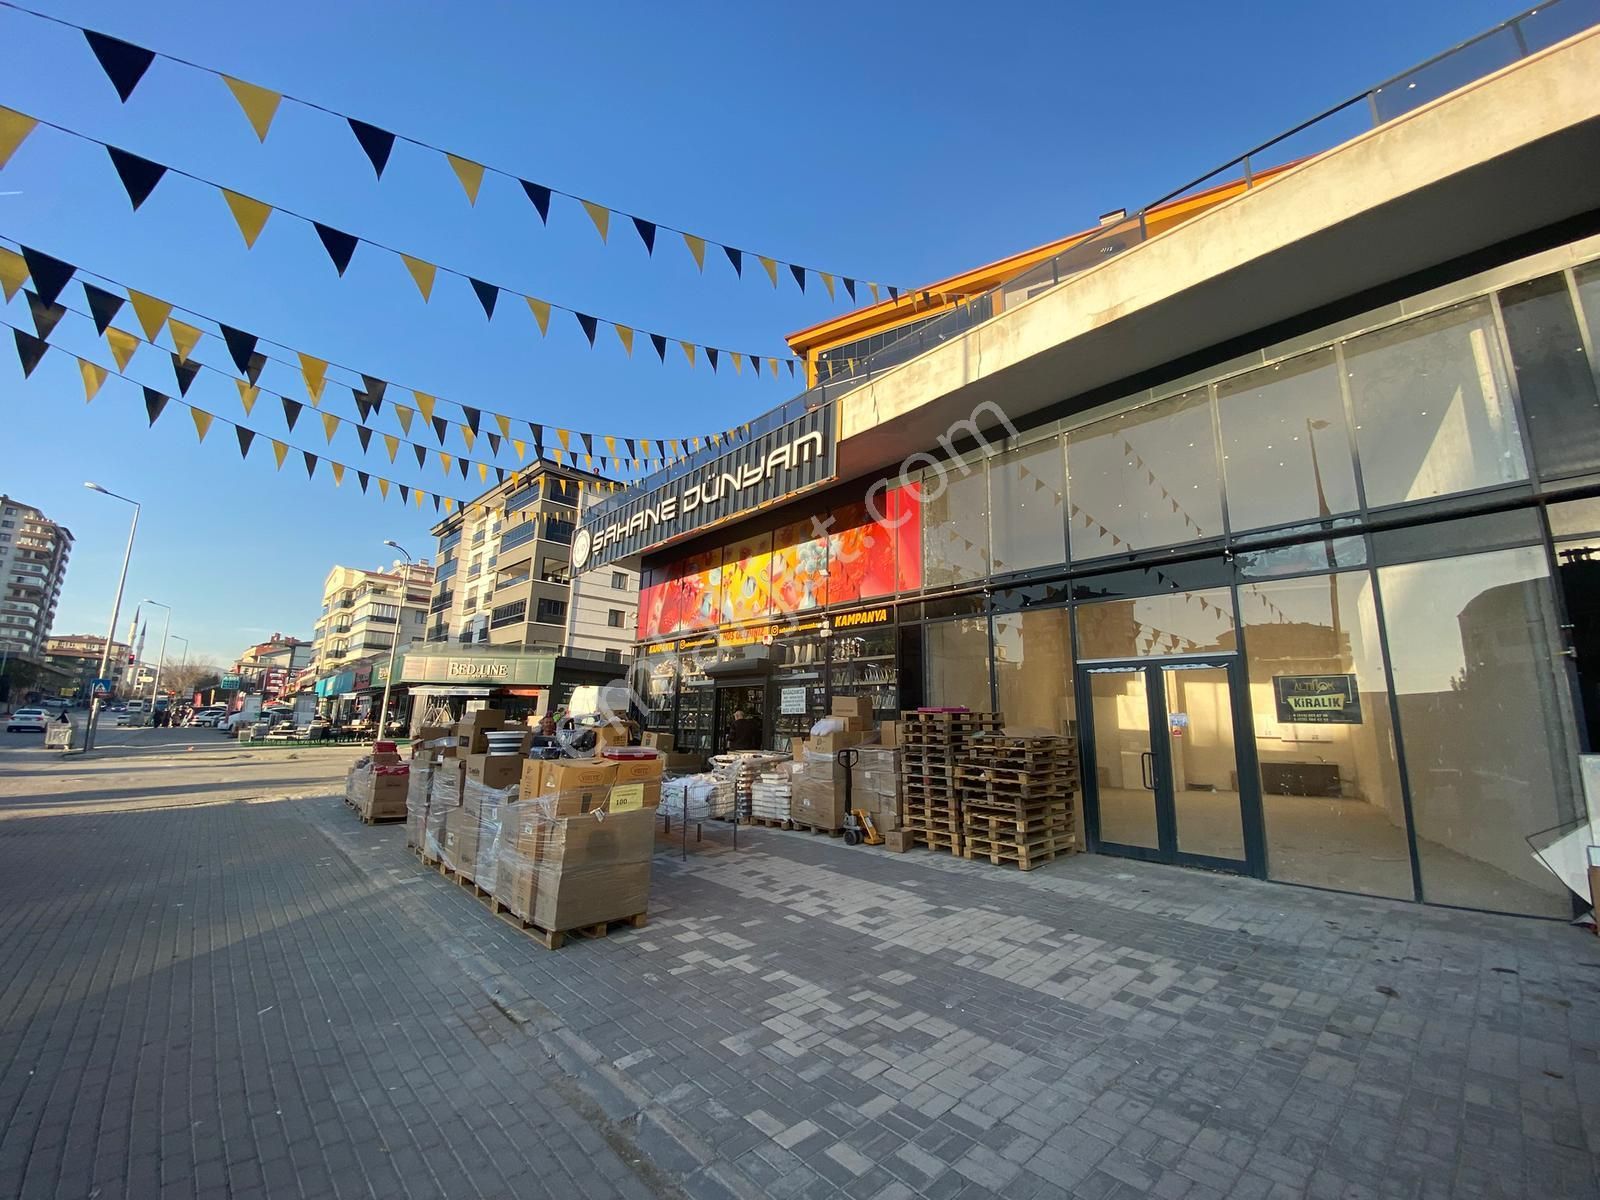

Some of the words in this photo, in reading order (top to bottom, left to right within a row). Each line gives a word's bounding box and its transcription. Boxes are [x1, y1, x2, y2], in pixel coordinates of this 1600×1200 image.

[591, 496, 679, 556] ŞAHANE
[683, 430, 824, 514] DÜNYAM
[834, 609, 887, 628] KAMPANYA
[616, 798, 628, 806] 100
